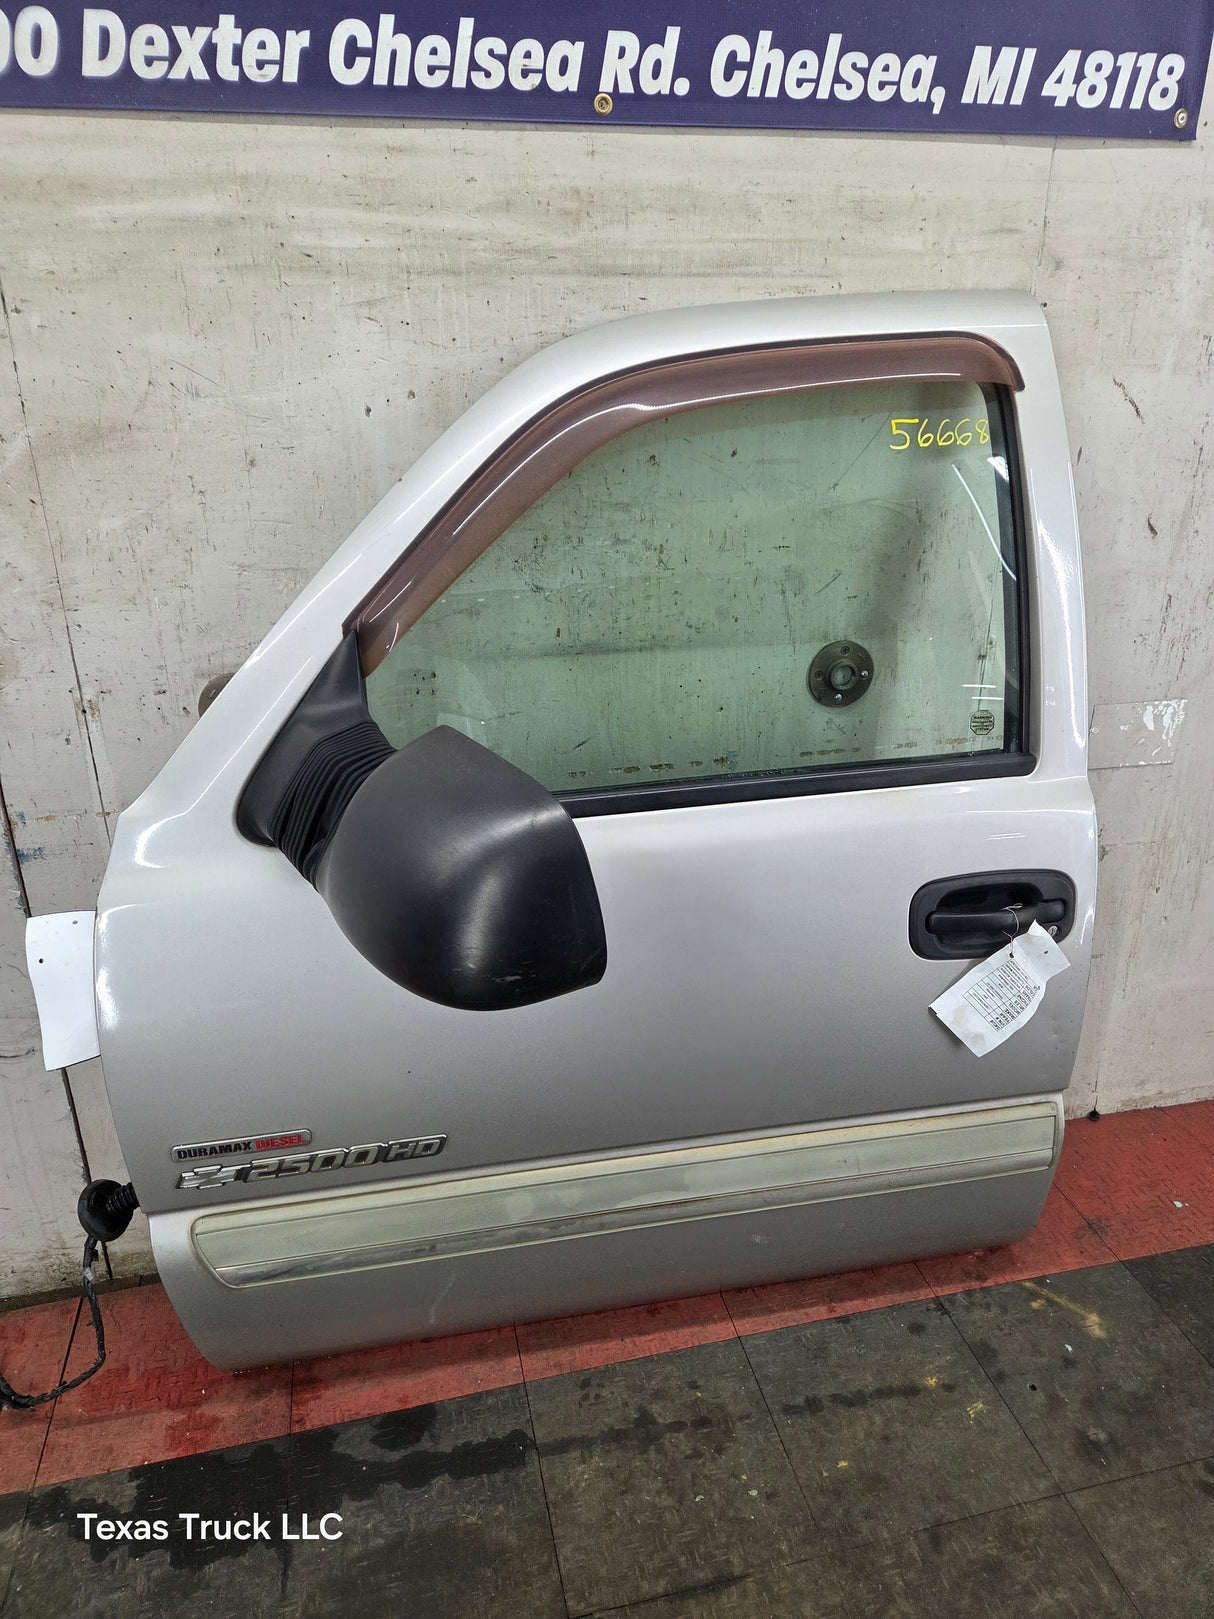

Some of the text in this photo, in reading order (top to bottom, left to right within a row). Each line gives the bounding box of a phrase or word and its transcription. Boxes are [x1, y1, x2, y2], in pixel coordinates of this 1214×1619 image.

[81, 8, 310, 84] Dexter
[328, 14, 584, 92] Chelsea
[600, 26, 690, 96] Rd.
[710, 31, 946, 114] Chelsea,
[960, 45, 1037, 105] MI
[1041, 49, 1185, 111] 48118
[889, 418, 989, 450] 56668
[177, 1133, 306, 1160] DURAMAX DIESEL
[247, 1135, 447, 1182] 2500 HD
